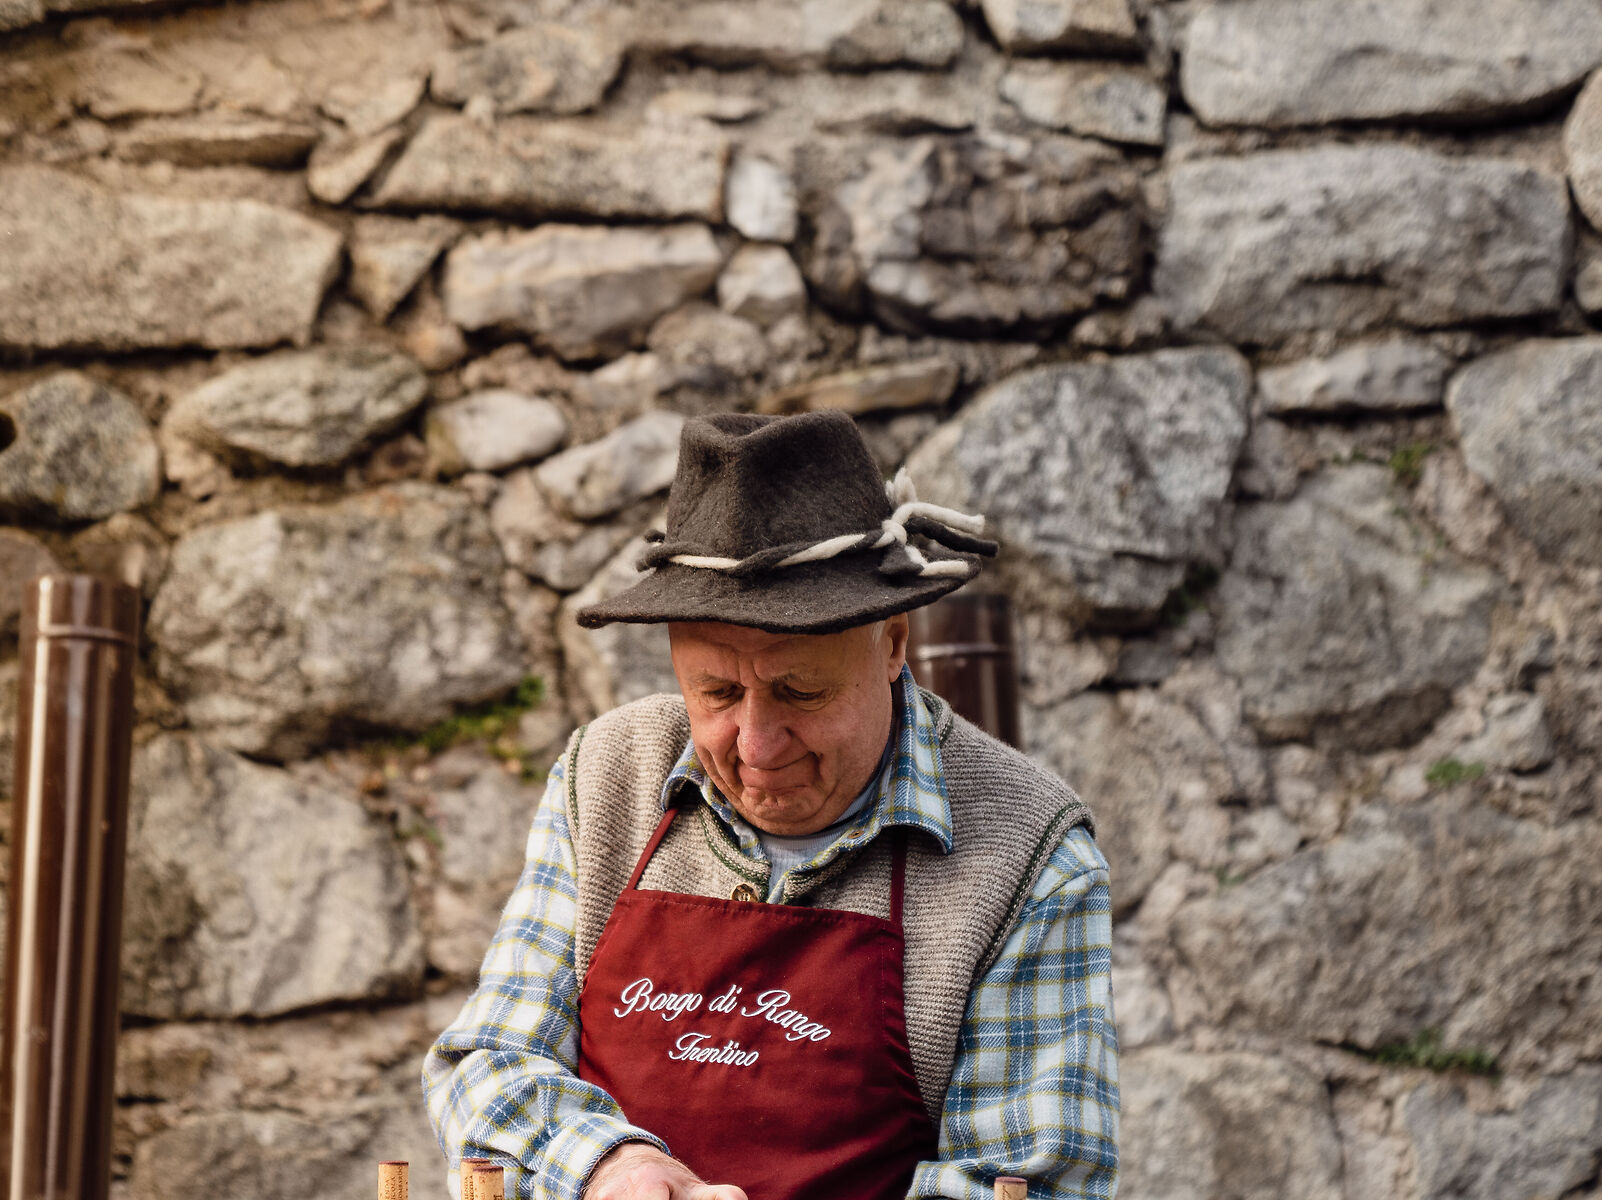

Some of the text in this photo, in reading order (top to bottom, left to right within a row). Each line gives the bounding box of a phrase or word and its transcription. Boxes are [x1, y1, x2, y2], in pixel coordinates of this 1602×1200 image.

[613, 977, 832, 1042] Borgo di Rango
[668, 1032, 760, 1067] Trentino
